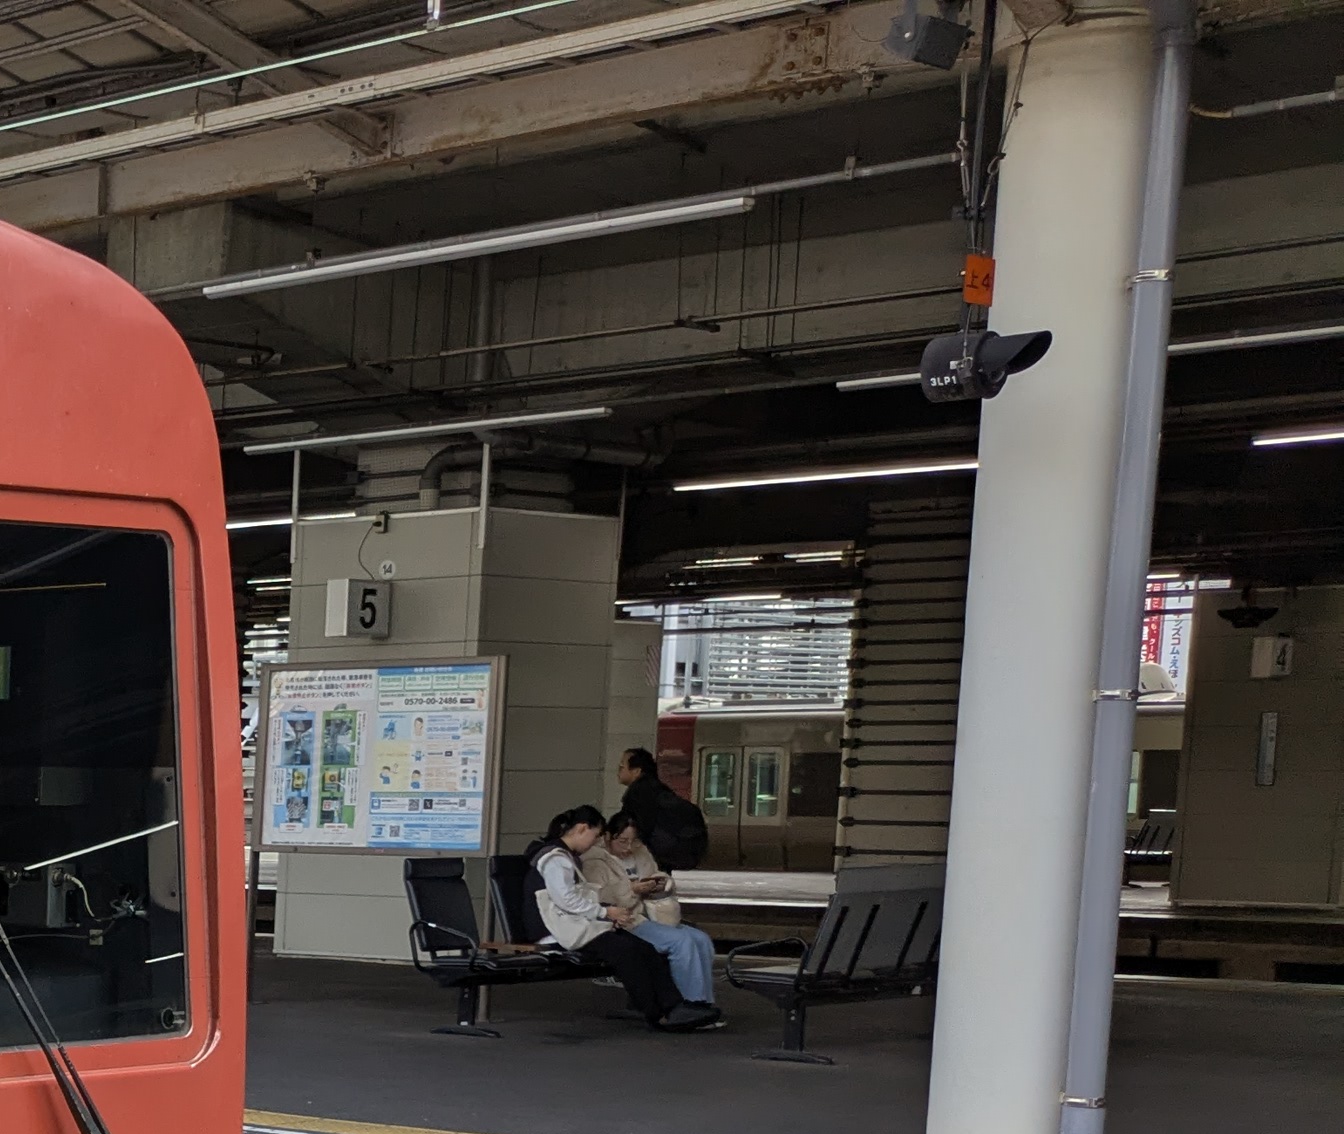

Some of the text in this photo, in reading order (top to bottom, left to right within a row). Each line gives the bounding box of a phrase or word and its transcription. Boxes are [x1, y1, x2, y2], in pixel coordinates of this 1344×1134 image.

[383, 563, 393, 575] 14
[359, 588, 377, 629] 5
[1276, 643, 1289, 668] 4
[404, 697, 458, 706] 0570-00-2486
